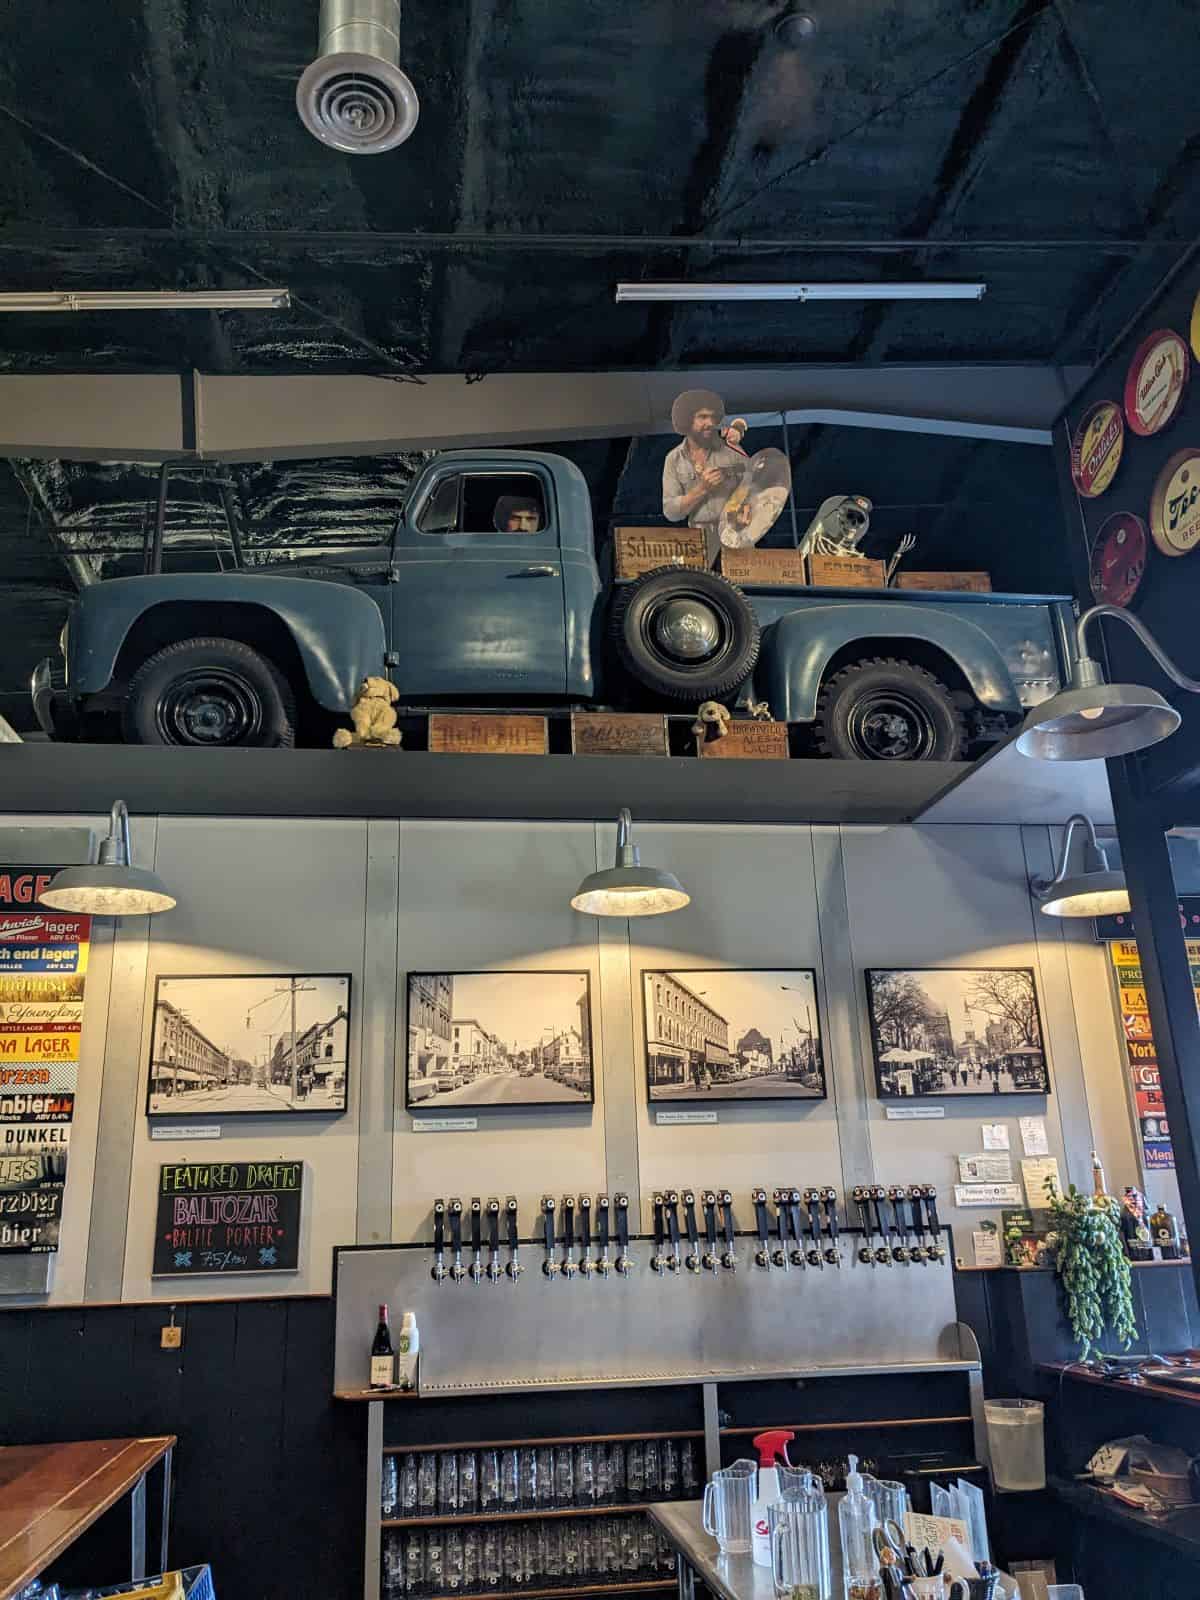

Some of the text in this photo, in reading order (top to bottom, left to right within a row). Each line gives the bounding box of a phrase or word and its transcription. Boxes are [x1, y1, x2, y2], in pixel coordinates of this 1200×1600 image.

[45, 921, 80, 934] lager
[0, 947, 77, 962] h end lager
[24, 1036, 70, 1053] LAGER
[0, 1068, 51, 1085] rzen
[0, 1094, 54, 1114] nbier
[5, 1127, 68, 1143] DUNKEL
[162, 1164, 300, 1190] FEATURED DRAFTS
[172, 1226, 274, 1249] BALTIC PORTER
